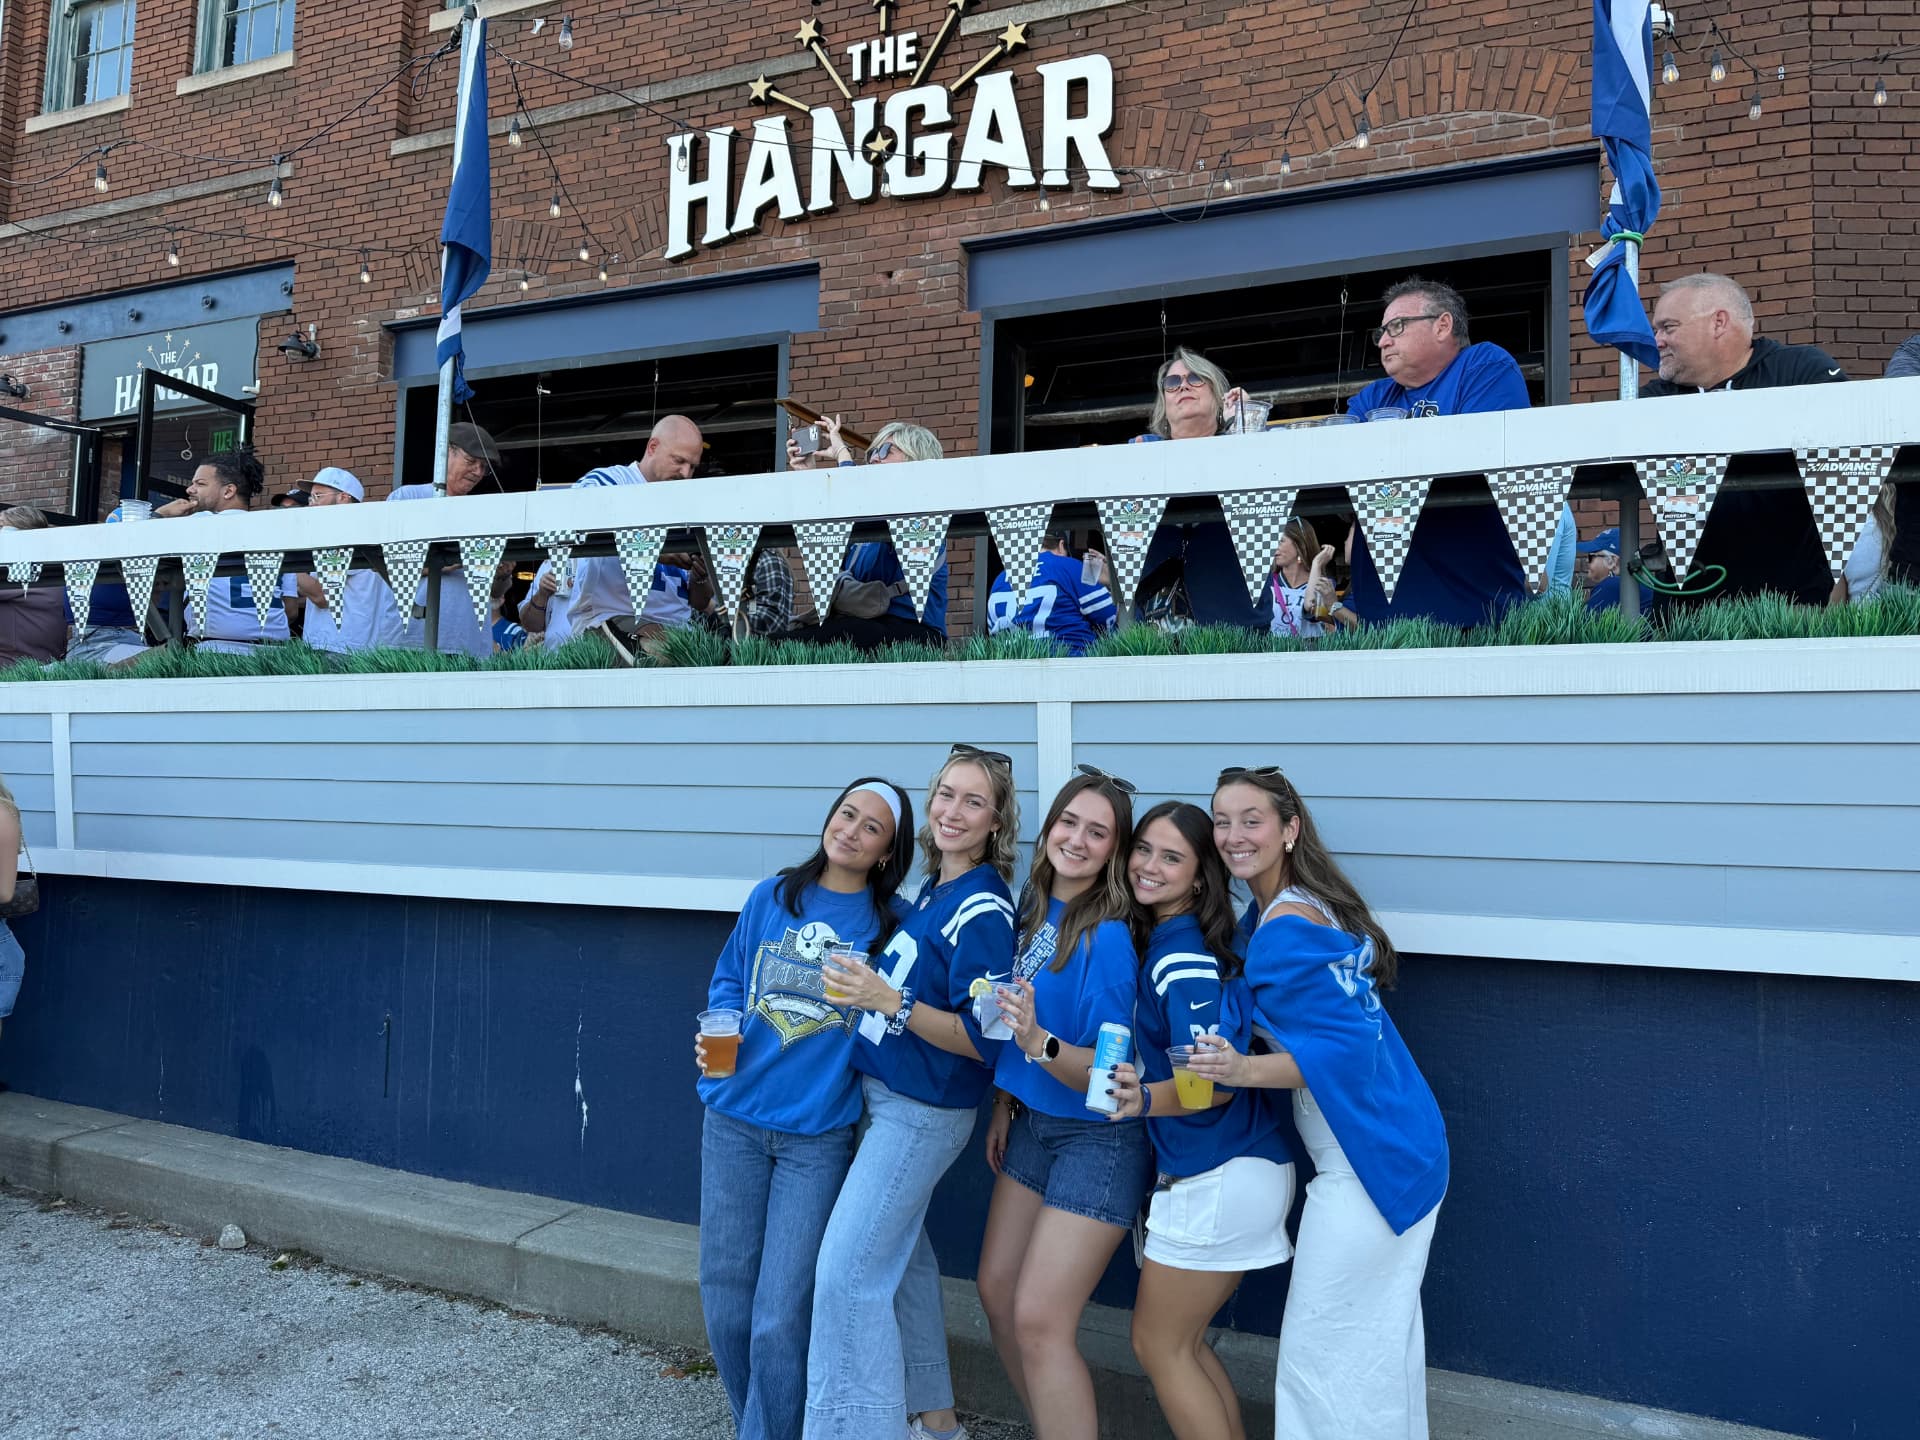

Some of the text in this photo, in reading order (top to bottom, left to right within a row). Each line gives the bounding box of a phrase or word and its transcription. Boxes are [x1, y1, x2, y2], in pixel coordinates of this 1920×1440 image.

[847, 31, 920, 83] THE
[665, 53, 1122, 261] HANGAR
[160, 351, 177, 364] THE
[1820, 462, 1880, 472] ADVANCE
[1511, 481, 1560, 493] ADVANCE
[1242, 505, 1286, 515] ADVANCE
[1008, 519, 1044, 529] ADVANCE
[811, 535, 845, 543] ADVANCE
